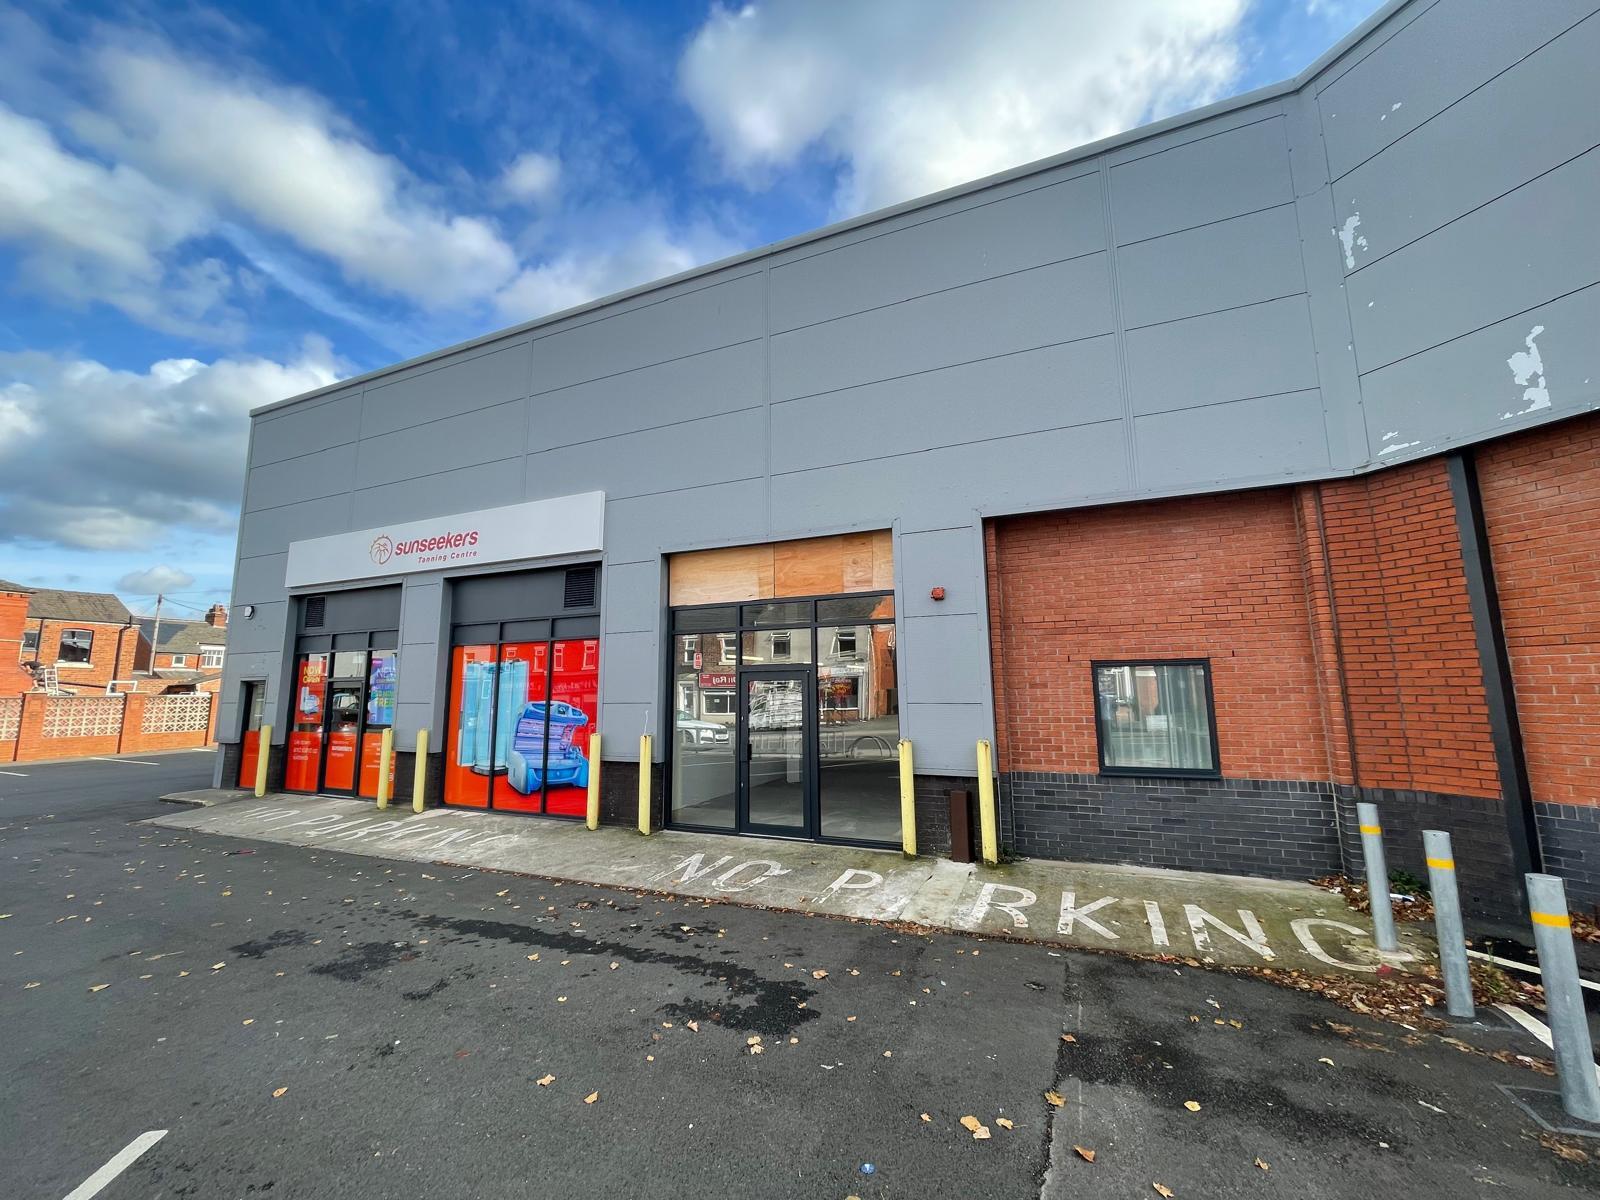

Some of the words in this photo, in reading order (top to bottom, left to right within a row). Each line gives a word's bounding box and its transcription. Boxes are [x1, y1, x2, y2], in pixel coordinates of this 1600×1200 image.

[394, 531, 479, 556] sunseekers
[418, 554, 447, 563] Tanning
[450, 550, 478, 560] Centre
[303, 666, 321, 675] NOW
[648, 852, 792, 892] NO
[811, 867, 1415, 975] PRKING
